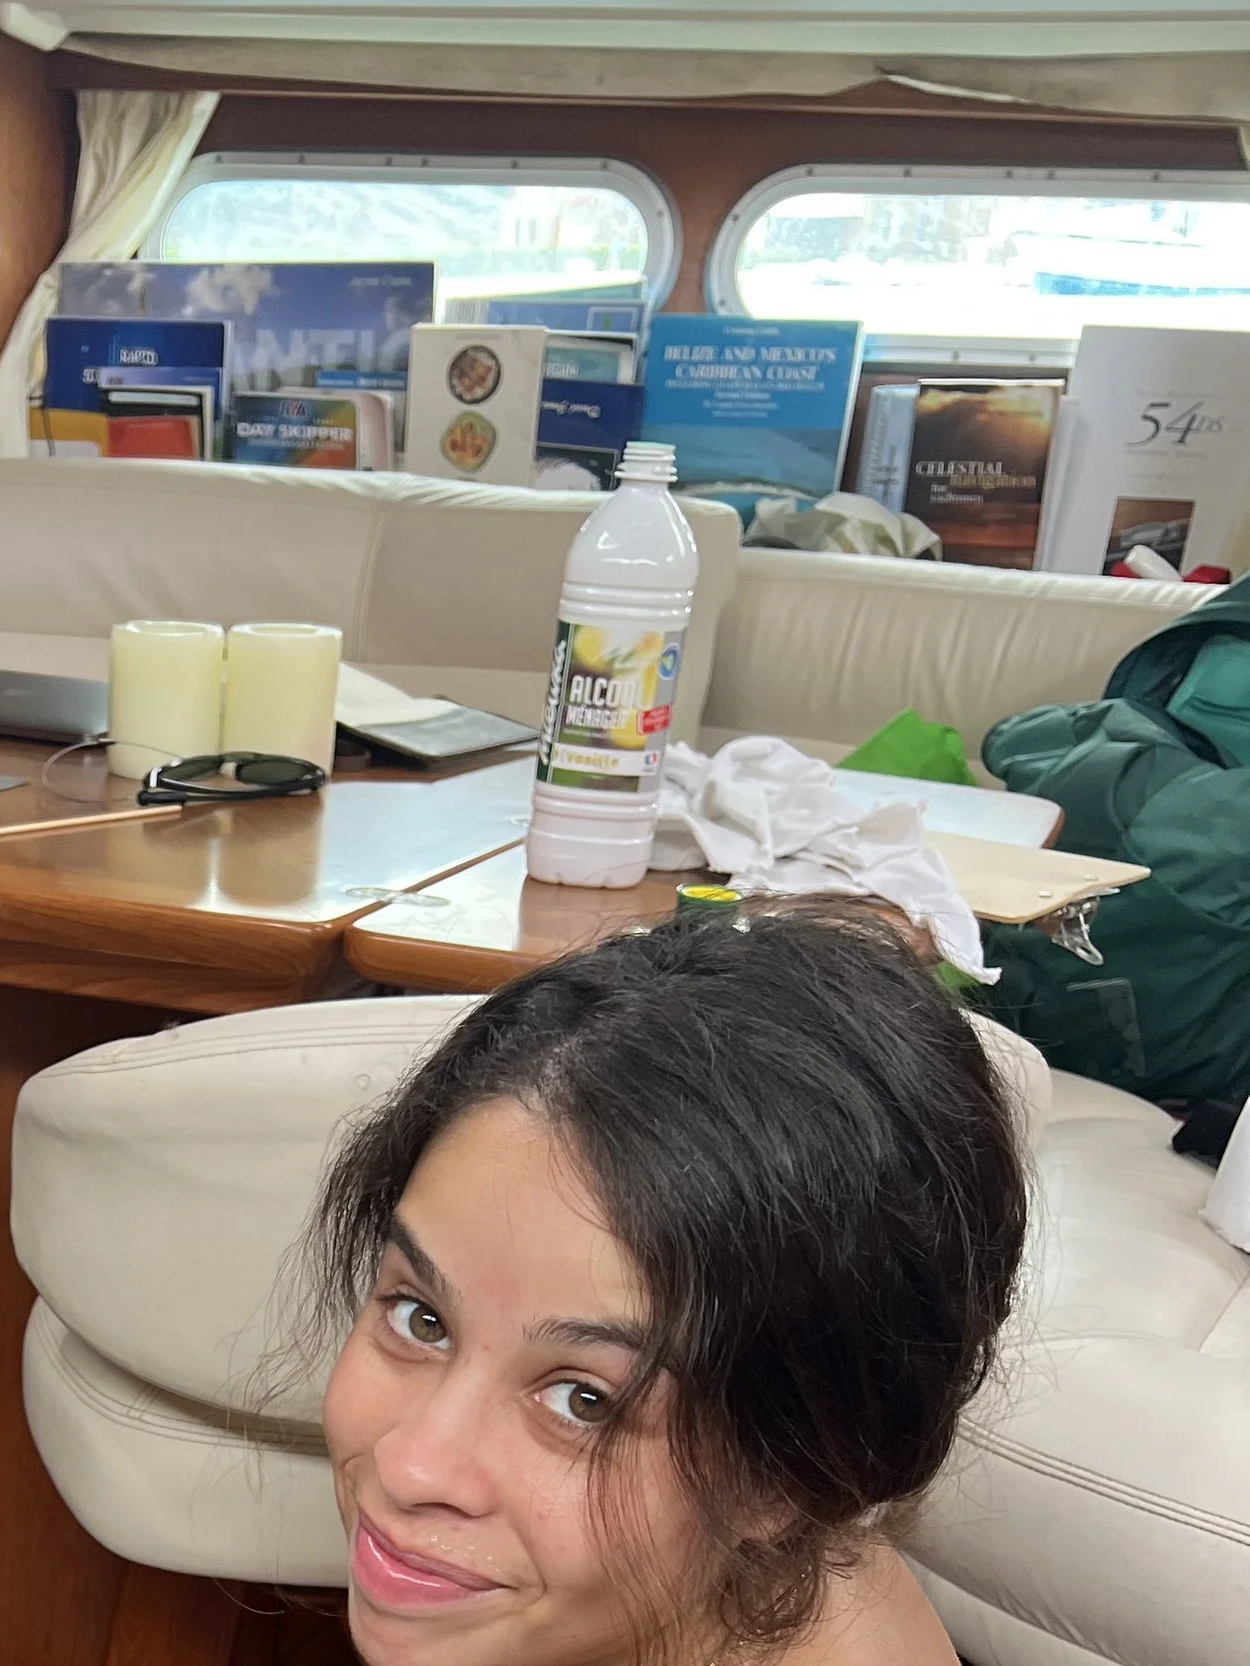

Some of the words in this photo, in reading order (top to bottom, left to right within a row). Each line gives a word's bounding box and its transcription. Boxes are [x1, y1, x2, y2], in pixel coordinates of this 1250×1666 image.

[724, 346, 756, 362] AND
[766, 364, 820, 381] COAST
[236, 421, 275, 438] DAY
[278, 423, 354, 441] SKIPPER
[915, 460, 1004, 476] CELESTIAL
[569, 674, 644, 709] ALCOOL
[565, 704, 631, 730] MÉNAGER
